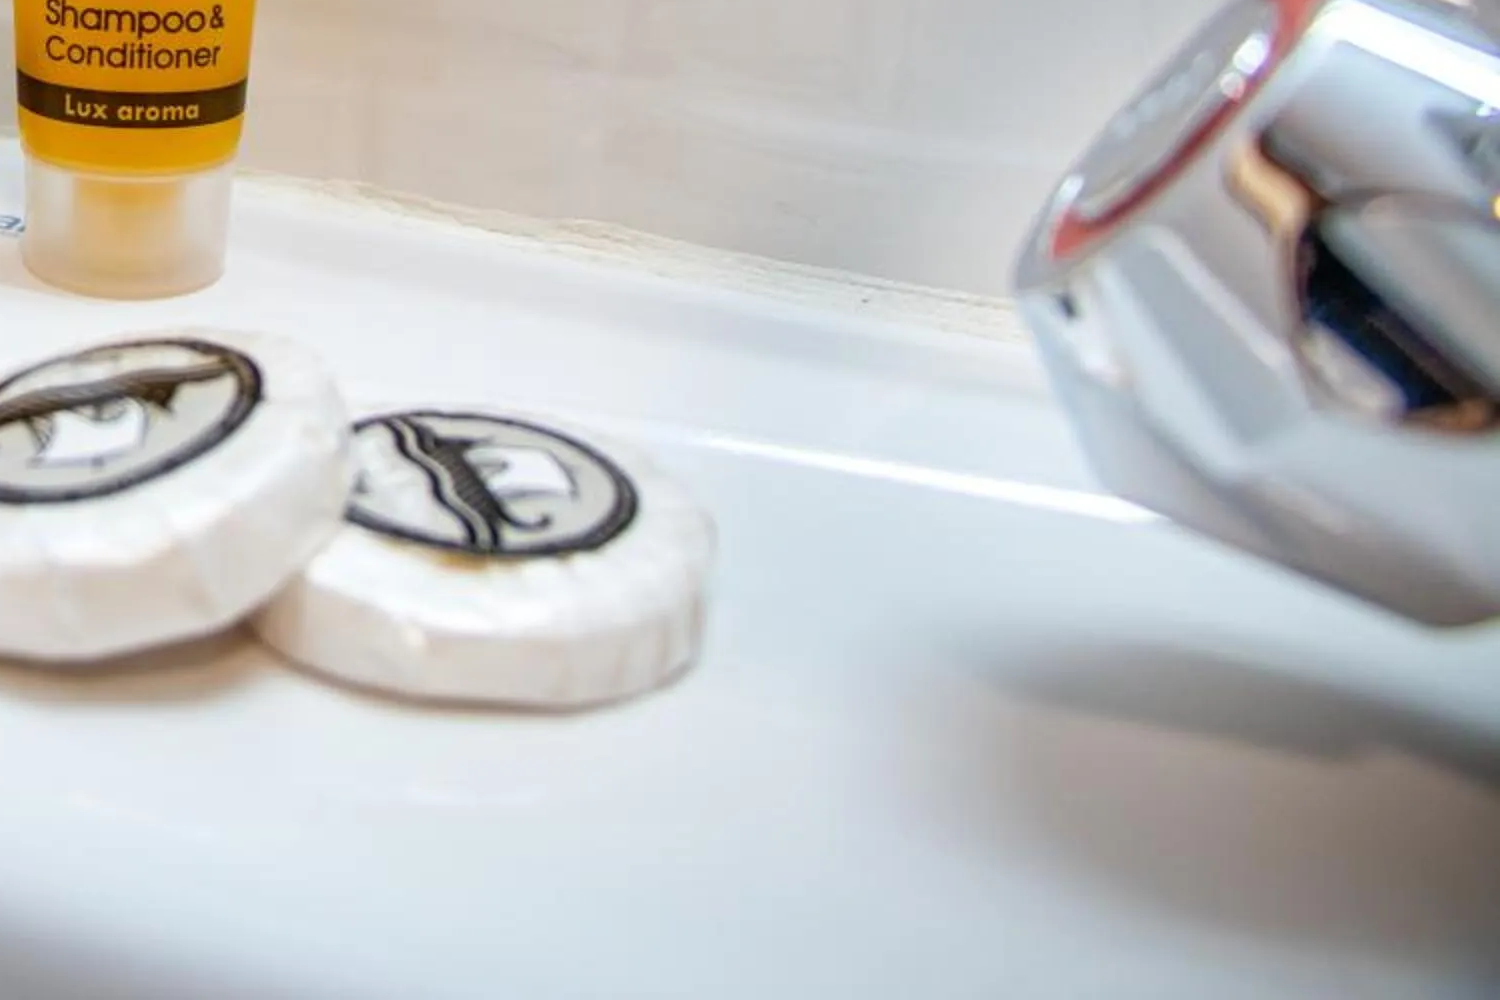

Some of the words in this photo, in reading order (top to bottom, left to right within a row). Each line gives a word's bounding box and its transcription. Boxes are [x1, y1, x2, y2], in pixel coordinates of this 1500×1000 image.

[45, 35, 221, 70] Conditioner
[64, 93, 108, 121] Lux
[117, 102, 200, 122] aroma
